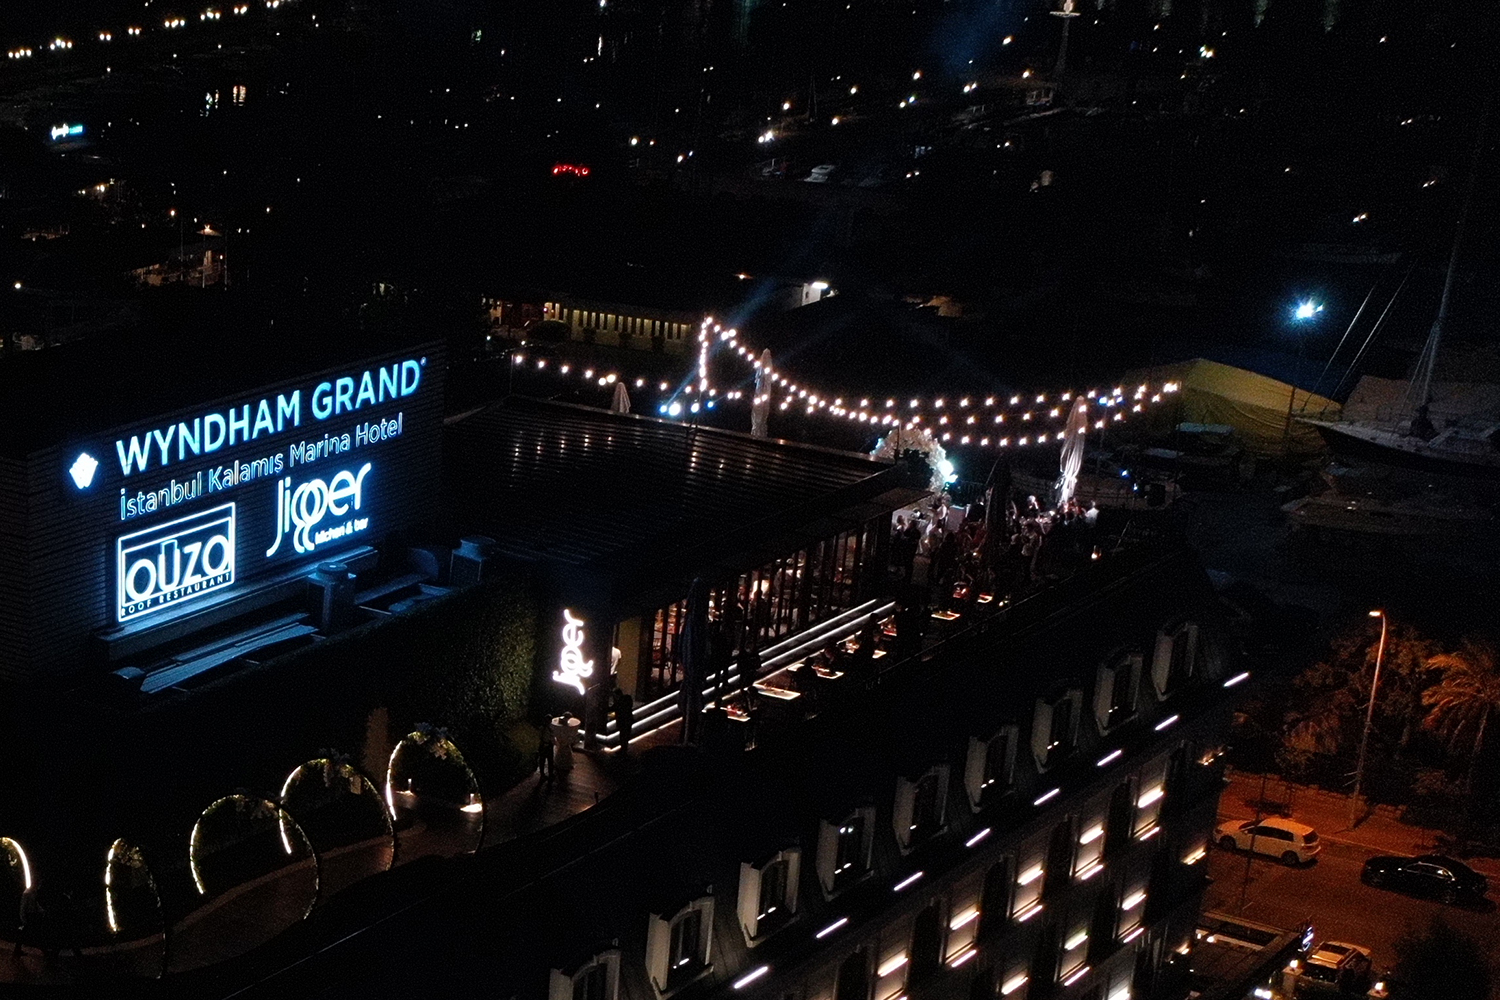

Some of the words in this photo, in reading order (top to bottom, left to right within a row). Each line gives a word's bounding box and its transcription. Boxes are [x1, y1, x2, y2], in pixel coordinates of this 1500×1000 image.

[115, 390, 300, 477] WYNDHAM
[120, 472, 202, 521] İstanbul
[290, 431, 351, 467] Marina
[356, 412, 404, 448] Hotel
[121, 601, 152, 617] ROOF
[159, 573, 230, 604] RESTAURANT
